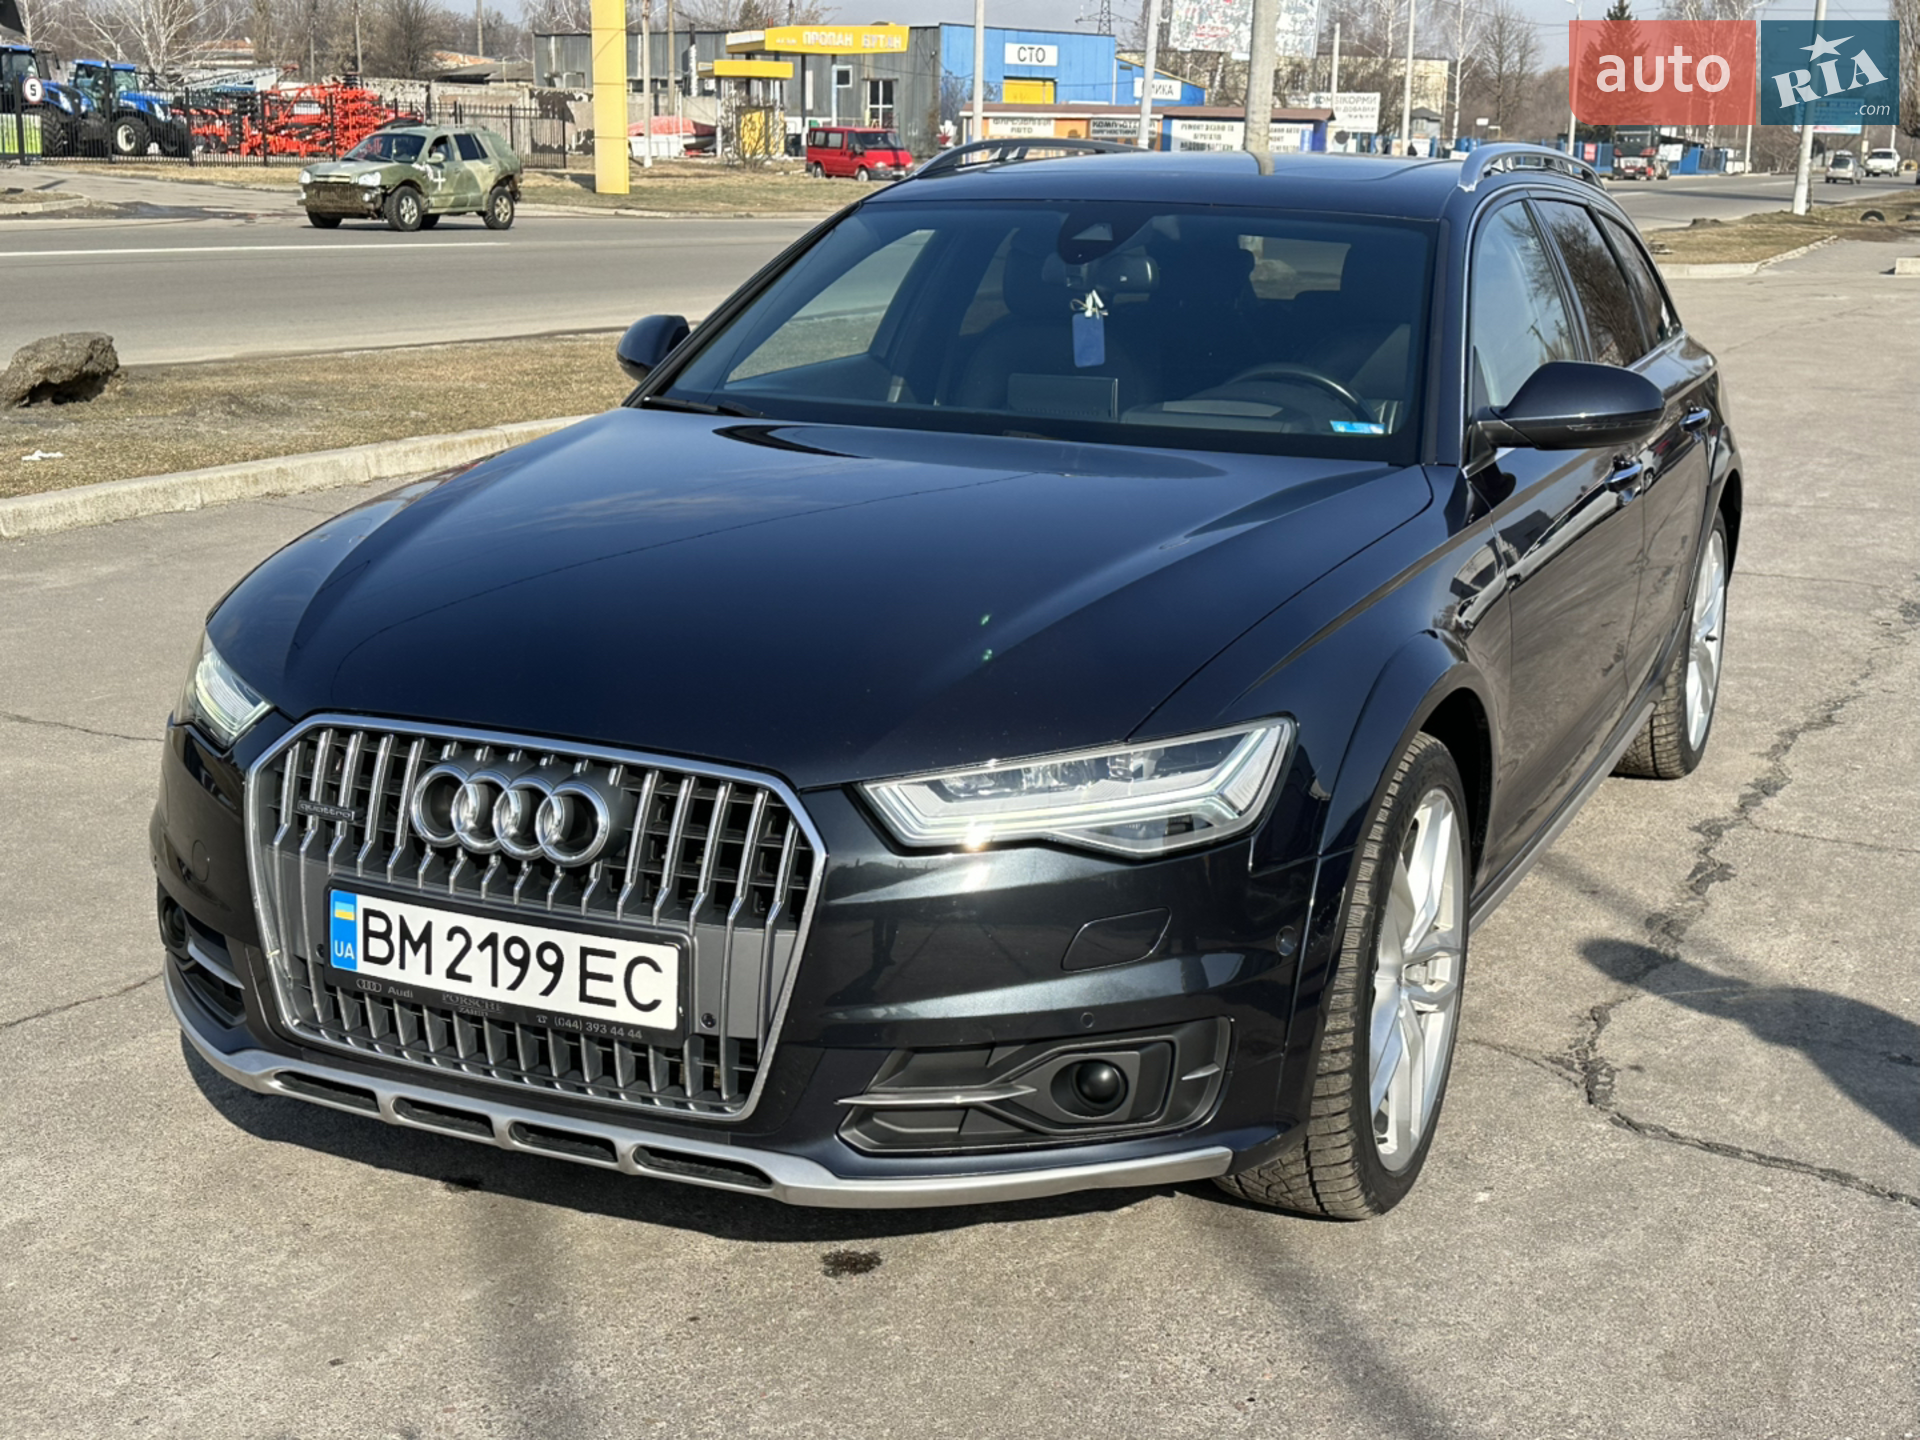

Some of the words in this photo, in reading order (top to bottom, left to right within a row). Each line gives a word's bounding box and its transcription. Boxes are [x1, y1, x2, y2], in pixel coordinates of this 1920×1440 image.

[802, 31, 853, 48] ПРОПАН
[861, 34, 902, 49] БУТАН
[1017, 46, 1046, 63] СТО
[300, 804, 351, 818] quattro
[334, 939, 355, 960] UA
[362, 907, 433, 976] BM
[446, 925, 565, 997] 2199
[579, 946, 663, 1013] EC
[387, 986, 414, 998] Audi
[442, 993, 503, 1012] PORSCHE
[554, 1016, 582, 1031] (044)
[586, 1022, 607, 1034] 393
[610, 1026, 625, 1037] 44
[627, 1029, 643, 1040] 44
